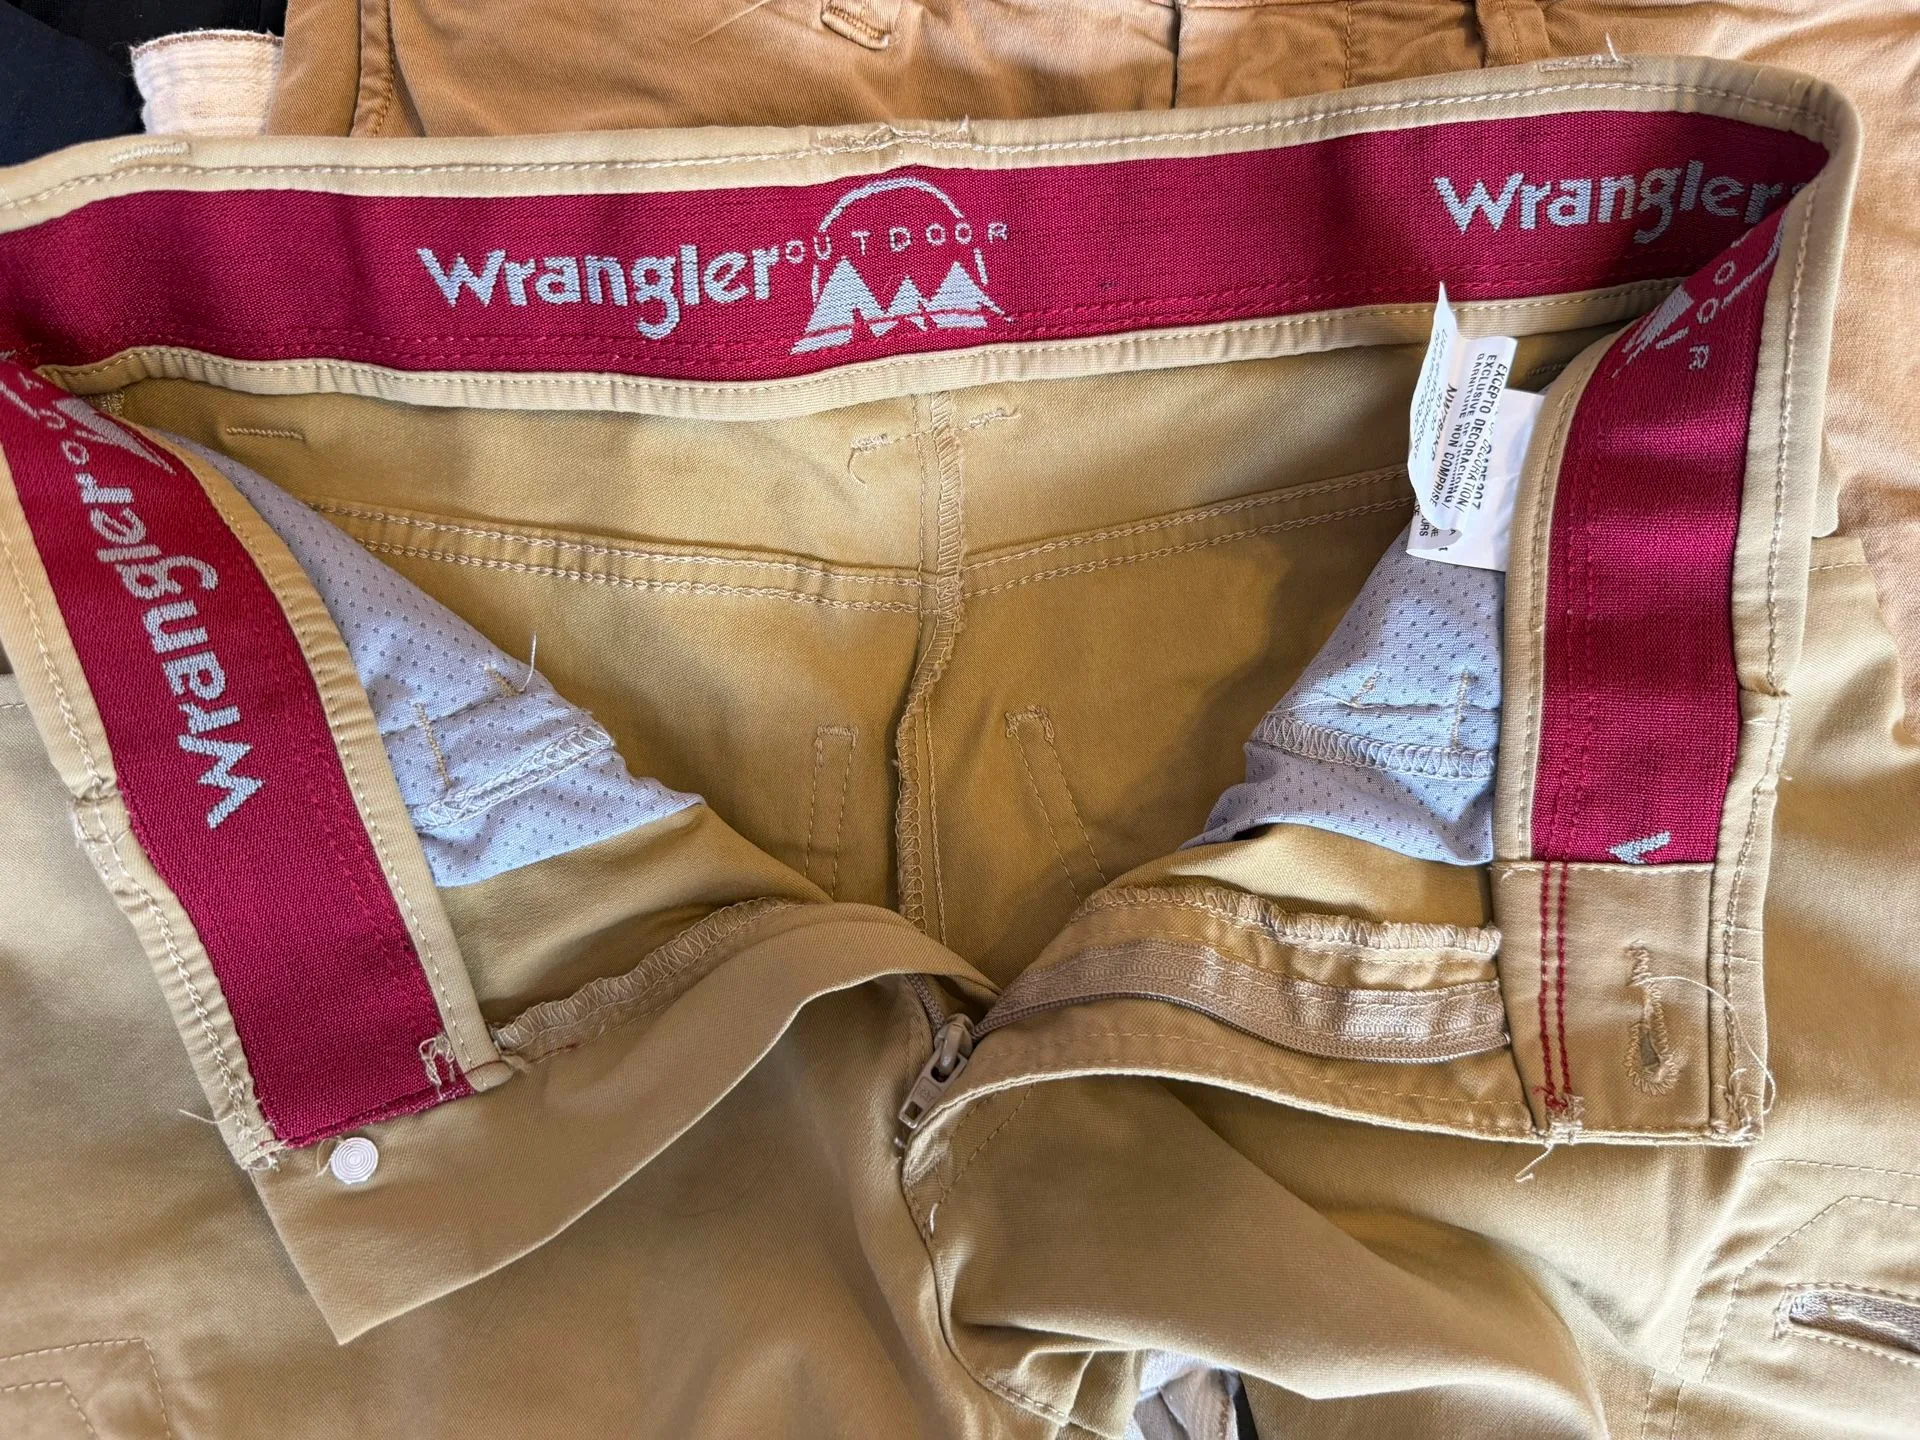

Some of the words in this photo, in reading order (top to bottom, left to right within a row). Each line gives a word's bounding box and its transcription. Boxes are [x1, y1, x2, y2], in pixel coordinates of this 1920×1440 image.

[1433, 160, 1785, 244] Wrangler
[416, 244, 779, 340] Wrangler
[785, 221, 1008, 264] OUTDOOR
[1466, 354, 1497, 416] EXCLUSIVE
[1479, 363, 1508, 414] EXCEPTO
[1448, 424, 1463, 447] NON
[1429, 452, 1455, 507] COMPRISE
[75, 472, 267, 830] Wrangler
